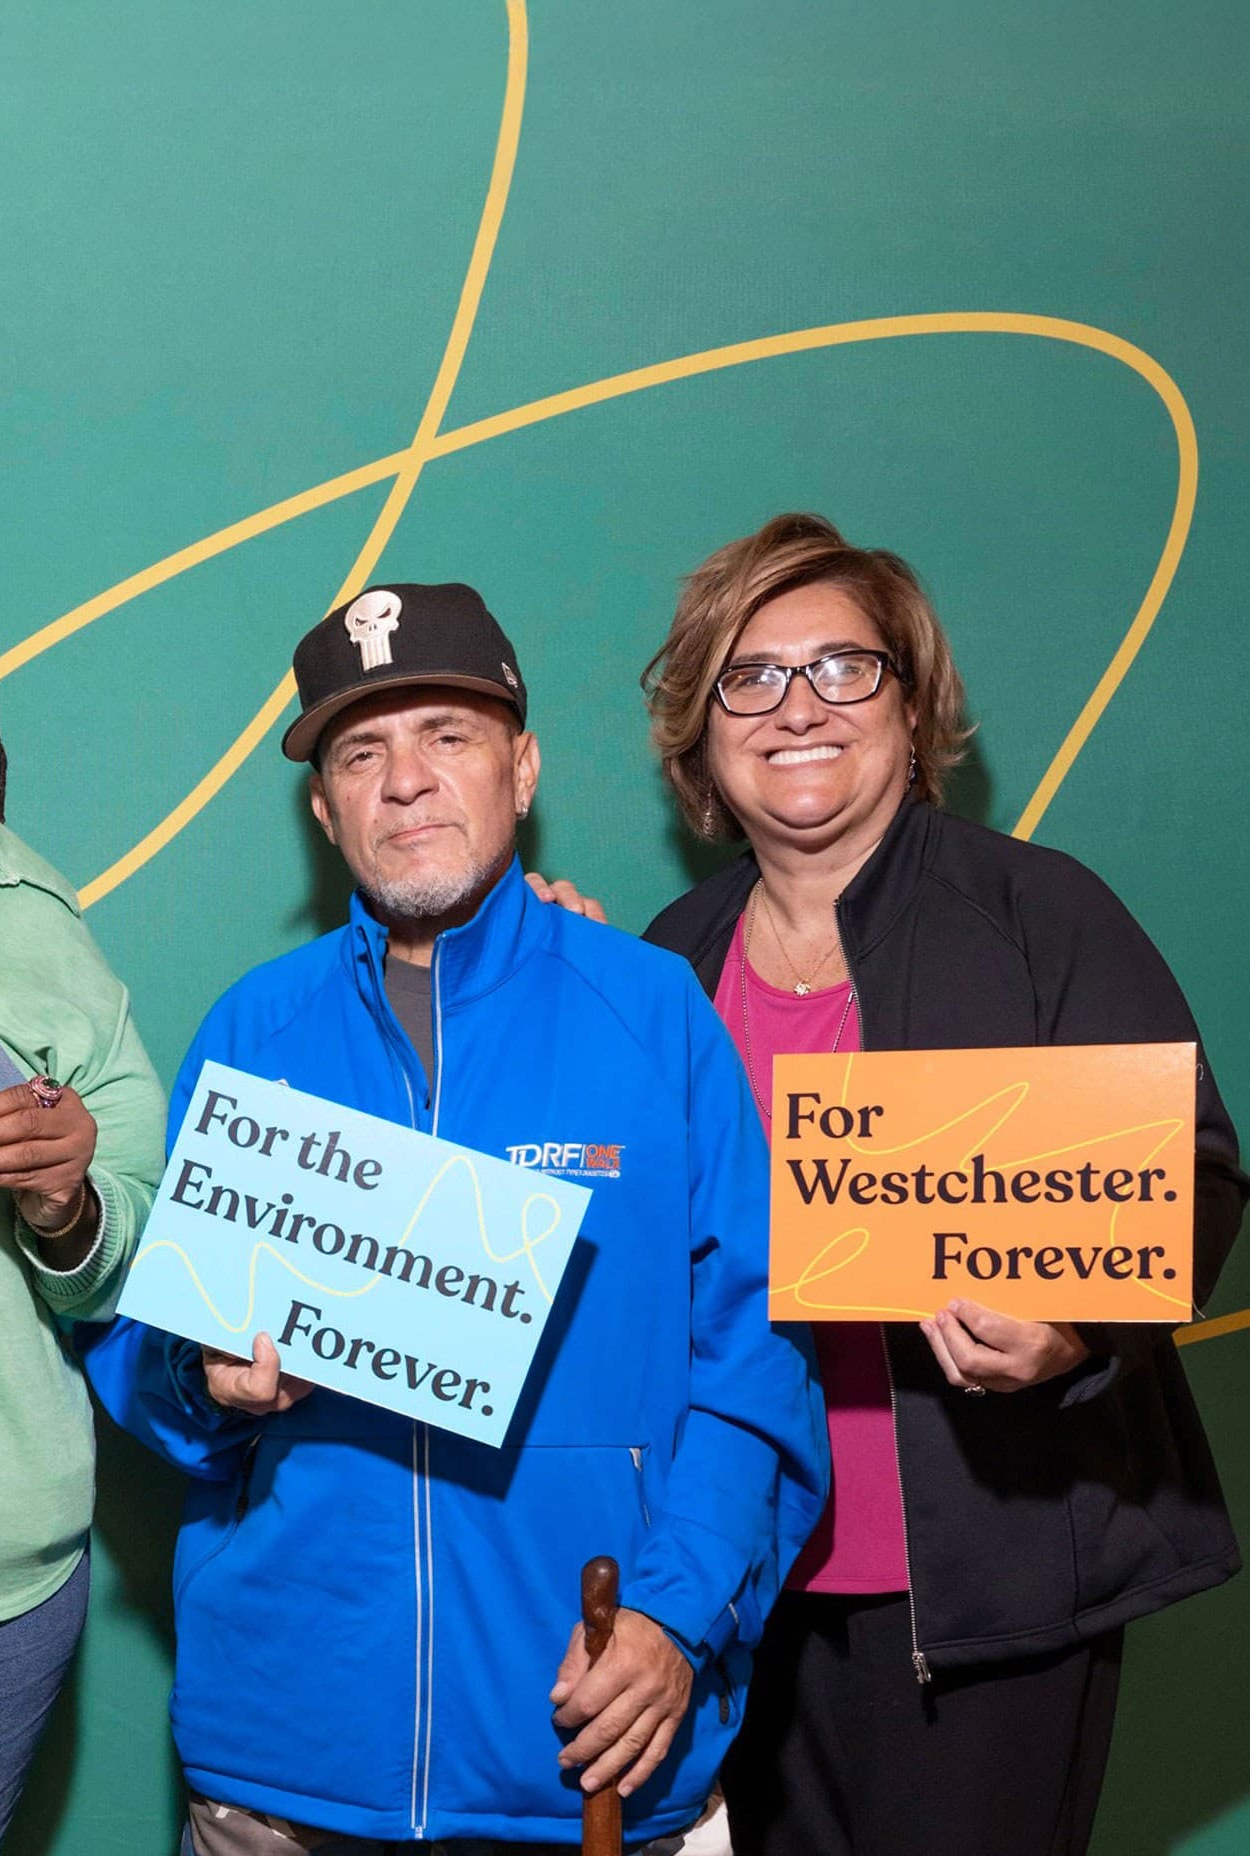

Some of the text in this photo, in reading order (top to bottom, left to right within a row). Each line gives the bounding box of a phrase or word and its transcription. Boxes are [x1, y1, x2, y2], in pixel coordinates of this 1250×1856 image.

[194, 1089, 384, 1191] For the
[786, 1092, 885, 1140] For
[785, 1153, 1178, 1206] Westchester.
[169, 1158, 533, 1325] Environment.
[931, 1232, 1178, 1281] Forever.
[277, 1299, 495, 1417] Forever.
